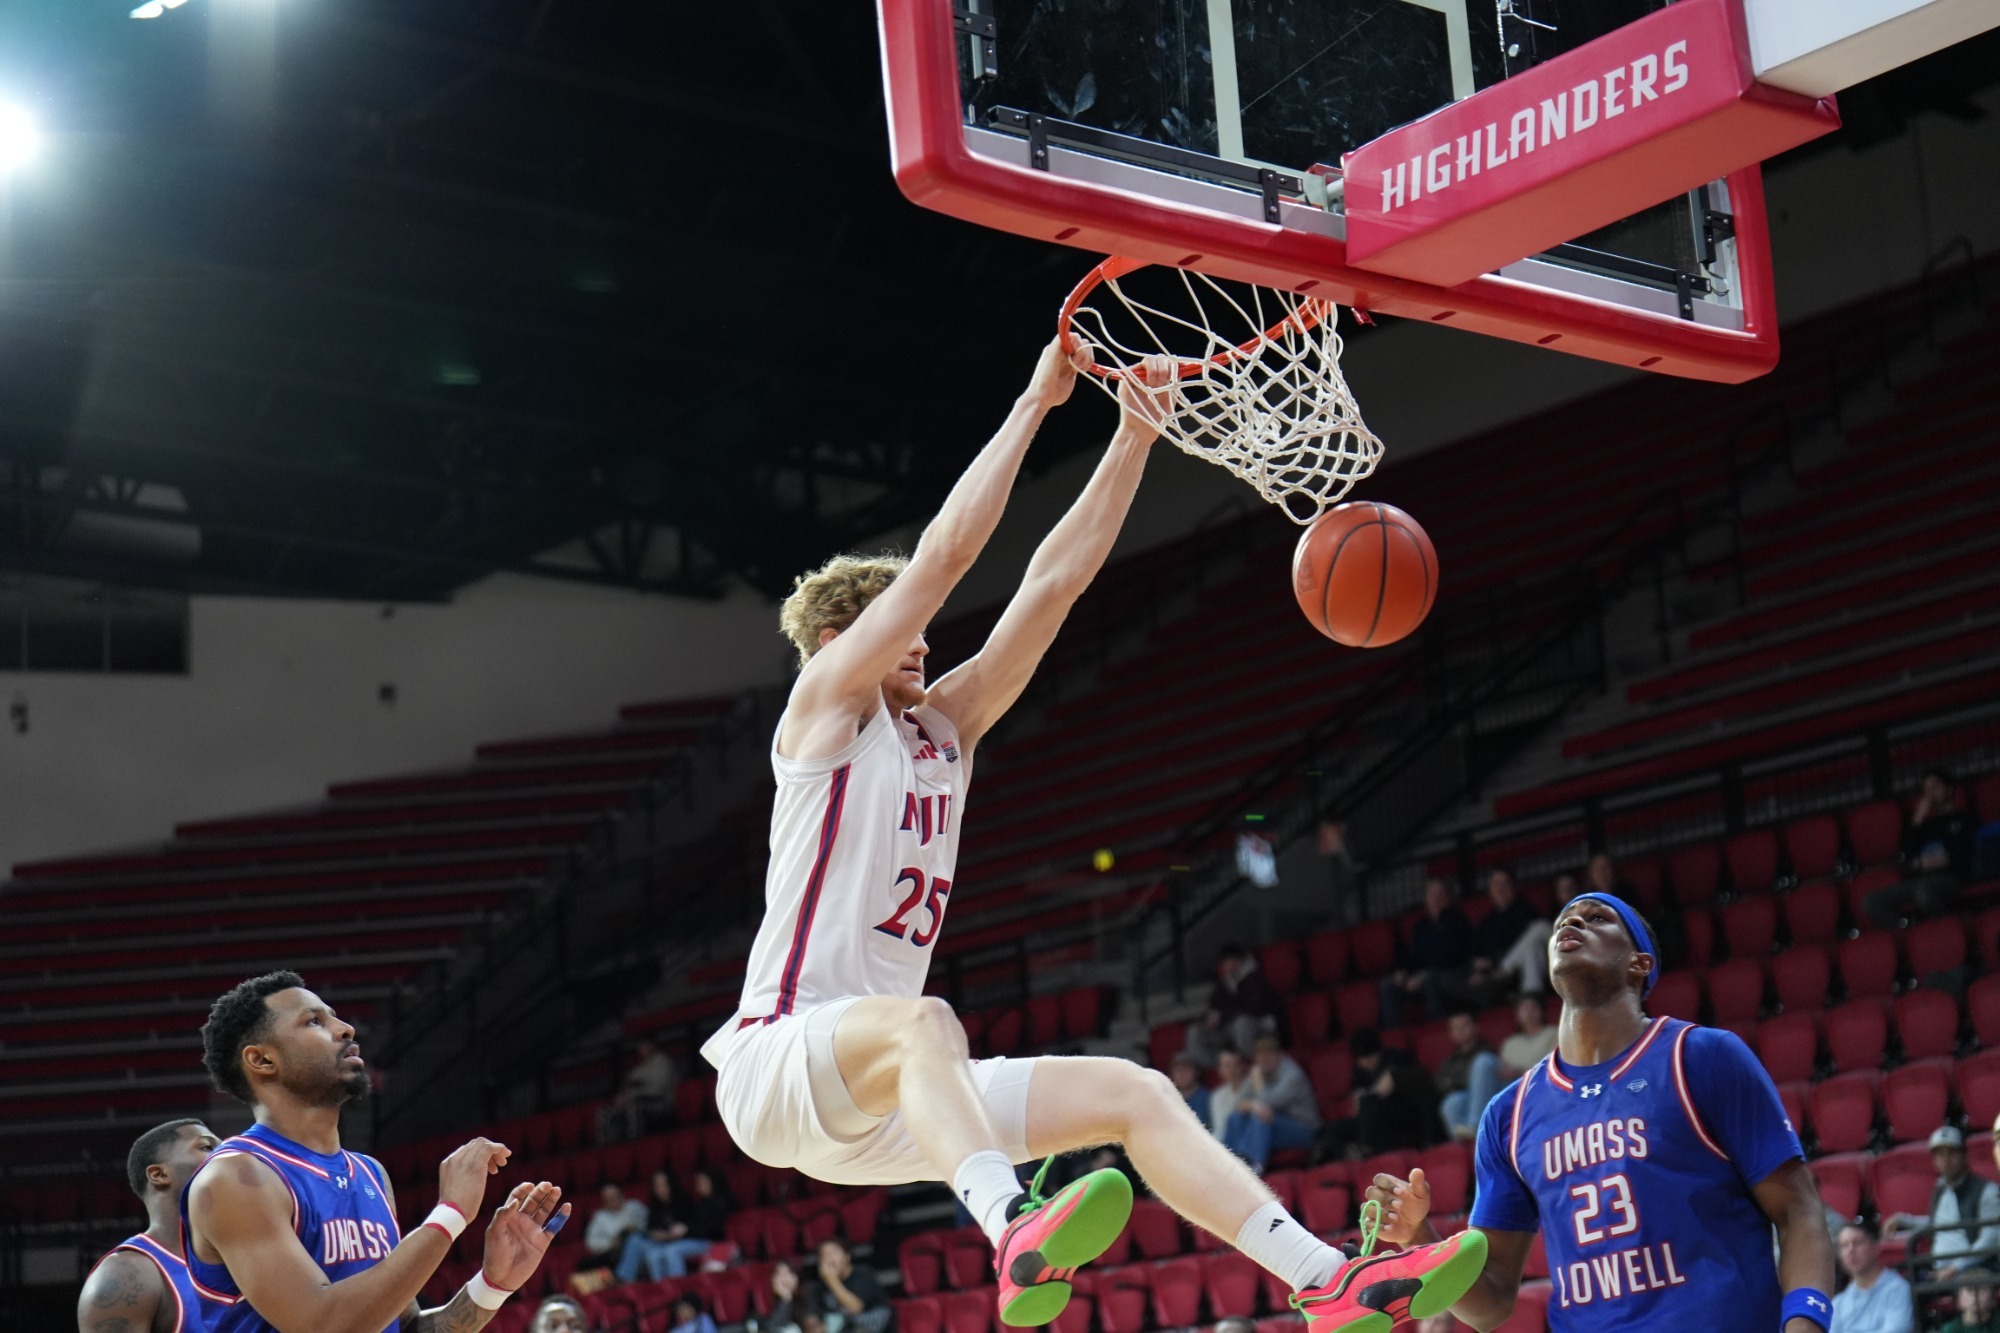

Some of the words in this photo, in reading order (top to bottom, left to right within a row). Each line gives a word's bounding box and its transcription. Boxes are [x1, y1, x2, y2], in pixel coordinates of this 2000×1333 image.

[1380, 39, 1689, 214] HIGHLANDERS
[872, 867, 951, 947] 25
[1543, 1117, 1648, 1181] UMASS
[323, 1218, 392, 1265] UMASS
[1570, 1173, 1639, 1245] 23
[1556, 1242, 1686, 1308] LOWELL
